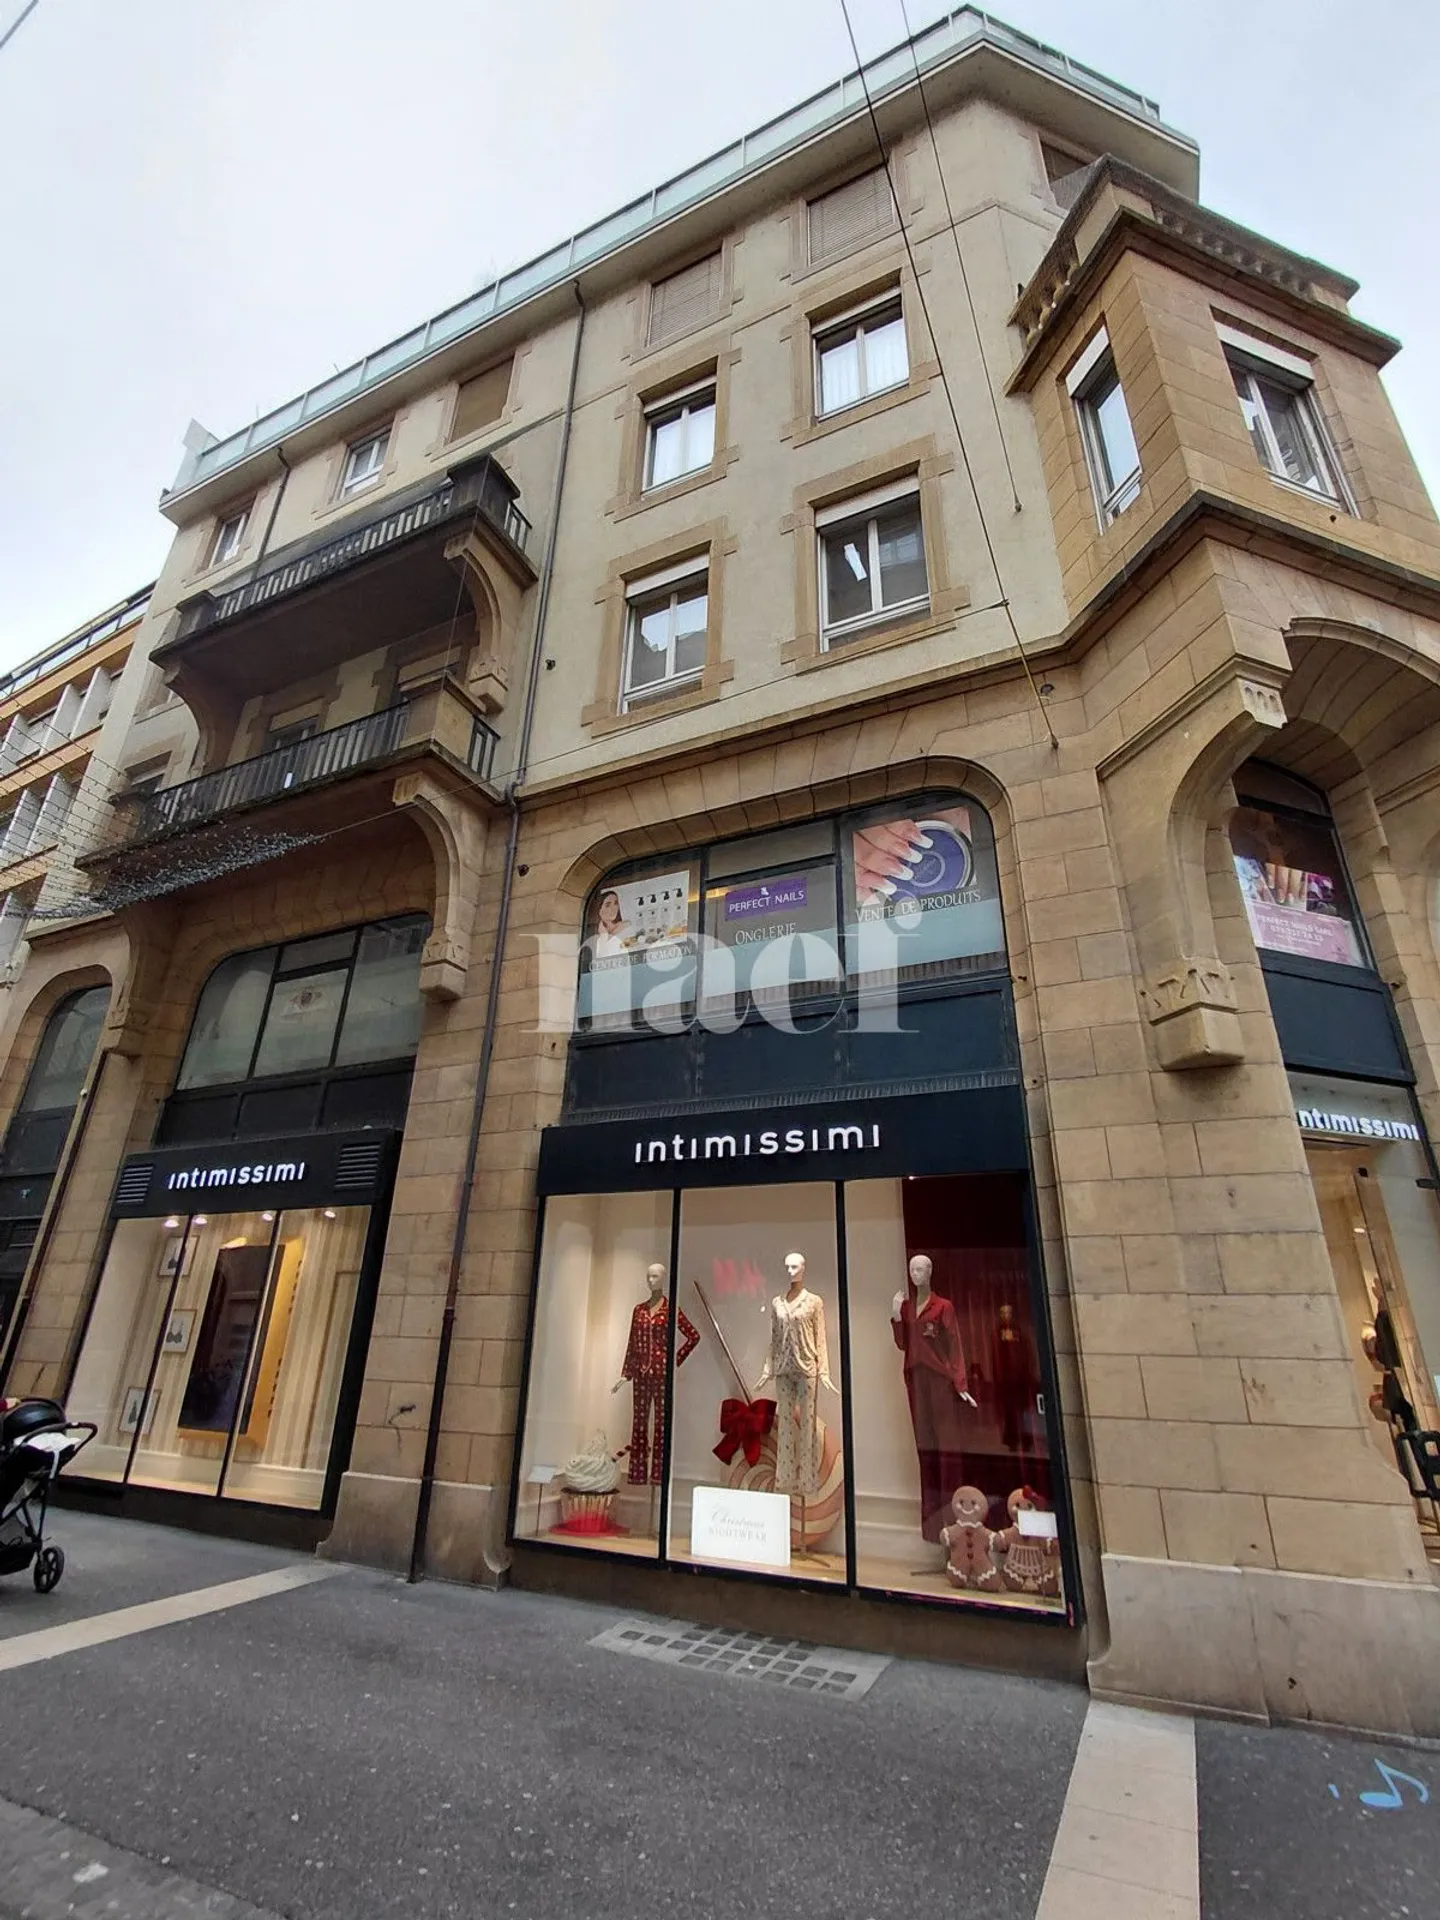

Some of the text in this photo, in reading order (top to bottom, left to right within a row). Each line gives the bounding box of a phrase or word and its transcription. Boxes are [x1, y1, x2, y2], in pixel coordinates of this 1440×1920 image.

[729, 890, 805, 913] PERFECT NAILS
[855, 889, 981, 923] VENTE DE PRODUITS
[735, 922, 797, 945] ONGLERIE
[1298, 1107, 1419, 1140] ntimissimi
[635, 1124, 880, 1163] intimissimi
[168, 1162, 305, 1190] intimissimi
